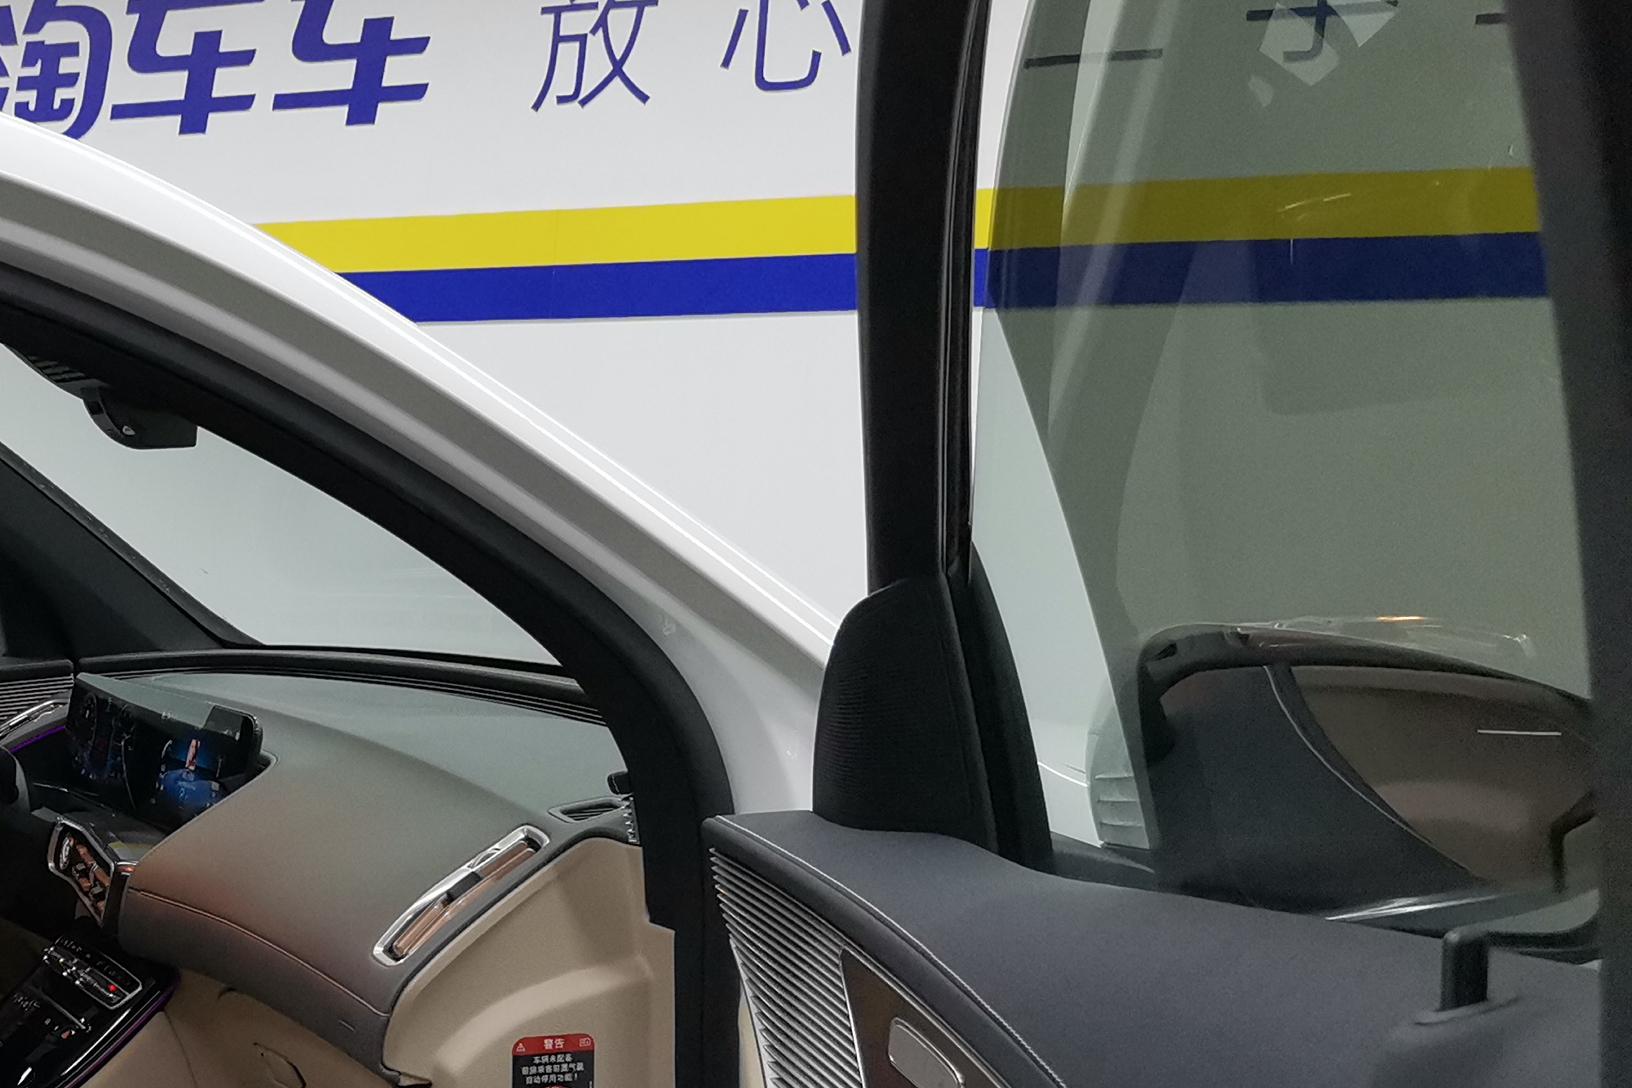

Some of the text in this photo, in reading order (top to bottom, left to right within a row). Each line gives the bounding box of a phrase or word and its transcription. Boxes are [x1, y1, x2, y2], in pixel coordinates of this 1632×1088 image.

[544, 1038, 565, 1050] 警告
[533, 1054, 573, 1064] 车辆未配备
